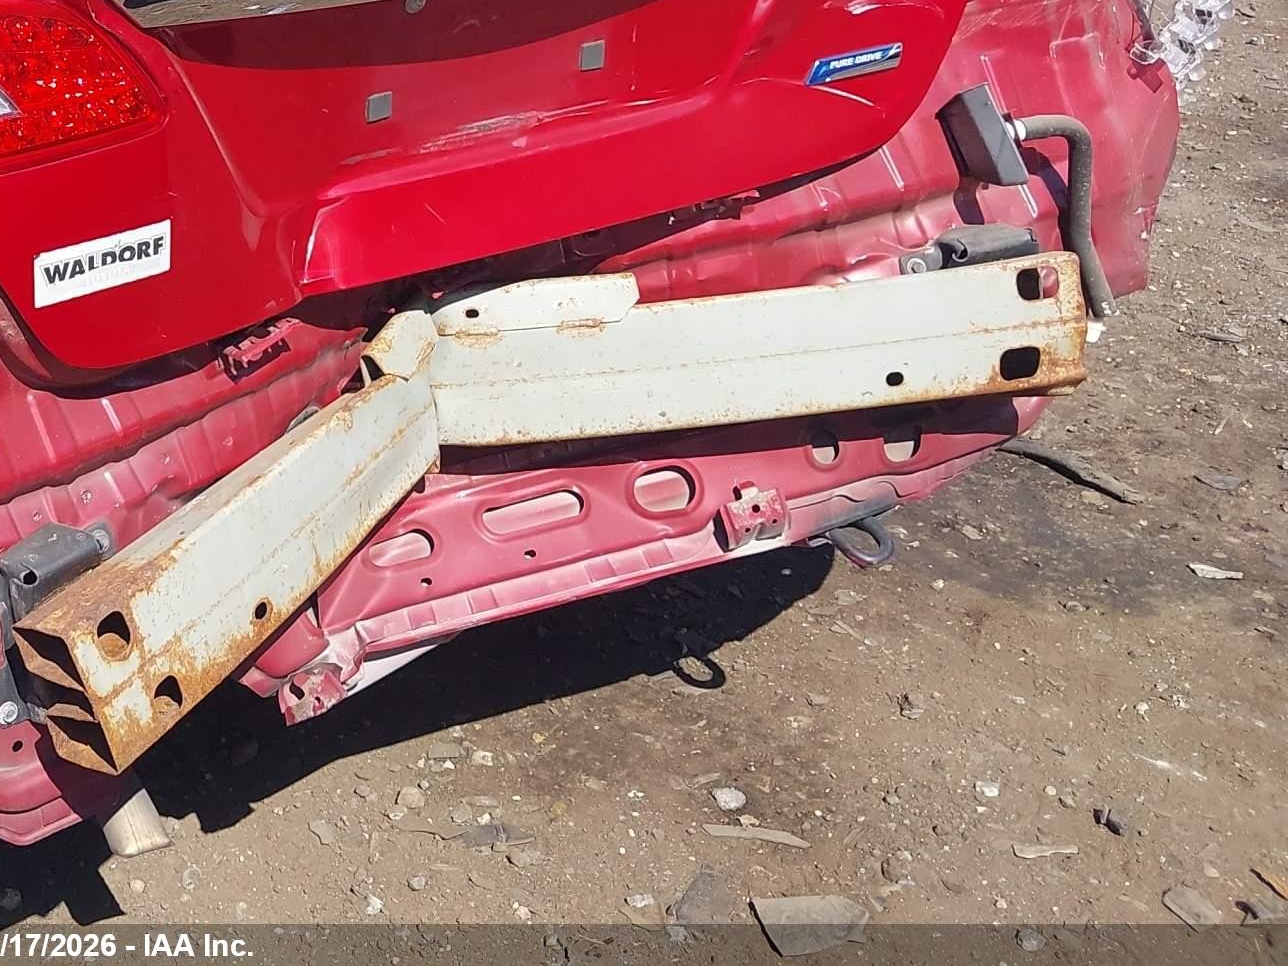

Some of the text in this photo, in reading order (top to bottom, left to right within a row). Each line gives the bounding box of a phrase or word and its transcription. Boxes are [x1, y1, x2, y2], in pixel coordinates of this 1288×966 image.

[829, 51, 884, 69] PURE DRIVE
[44, 236, 165, 285] WALDORF
